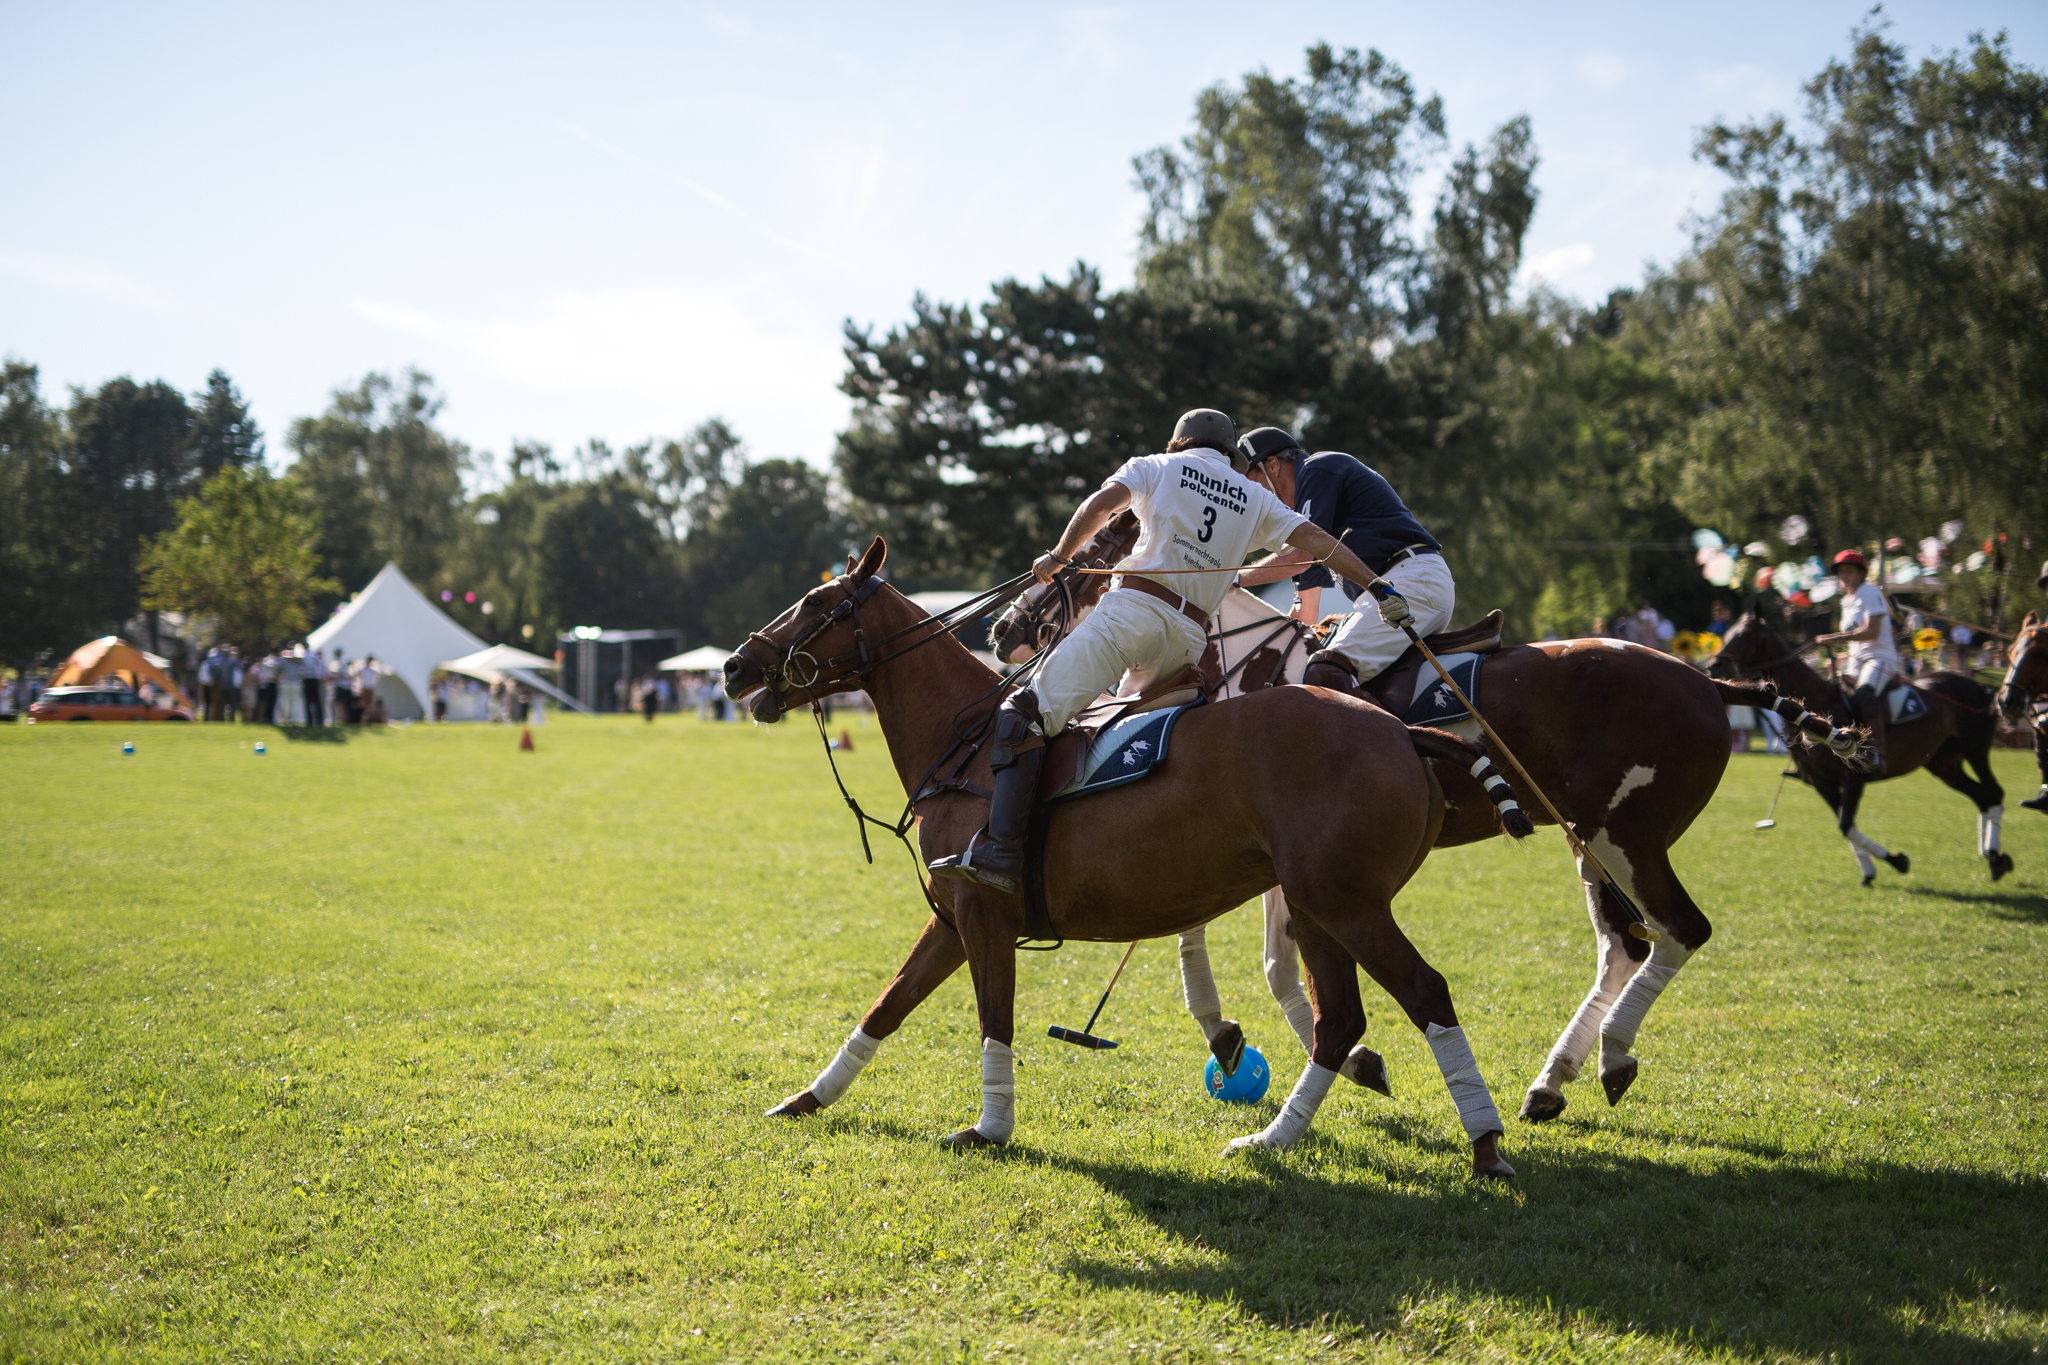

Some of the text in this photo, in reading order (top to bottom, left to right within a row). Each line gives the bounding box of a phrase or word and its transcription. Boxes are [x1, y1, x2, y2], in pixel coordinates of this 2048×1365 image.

[1180, 478, 1246, 515] polocenter
[1182, 464, 1248, 504] munich
[1197, 505, 1217, 543] 3
[1301, 499, 1312, 520] 4
